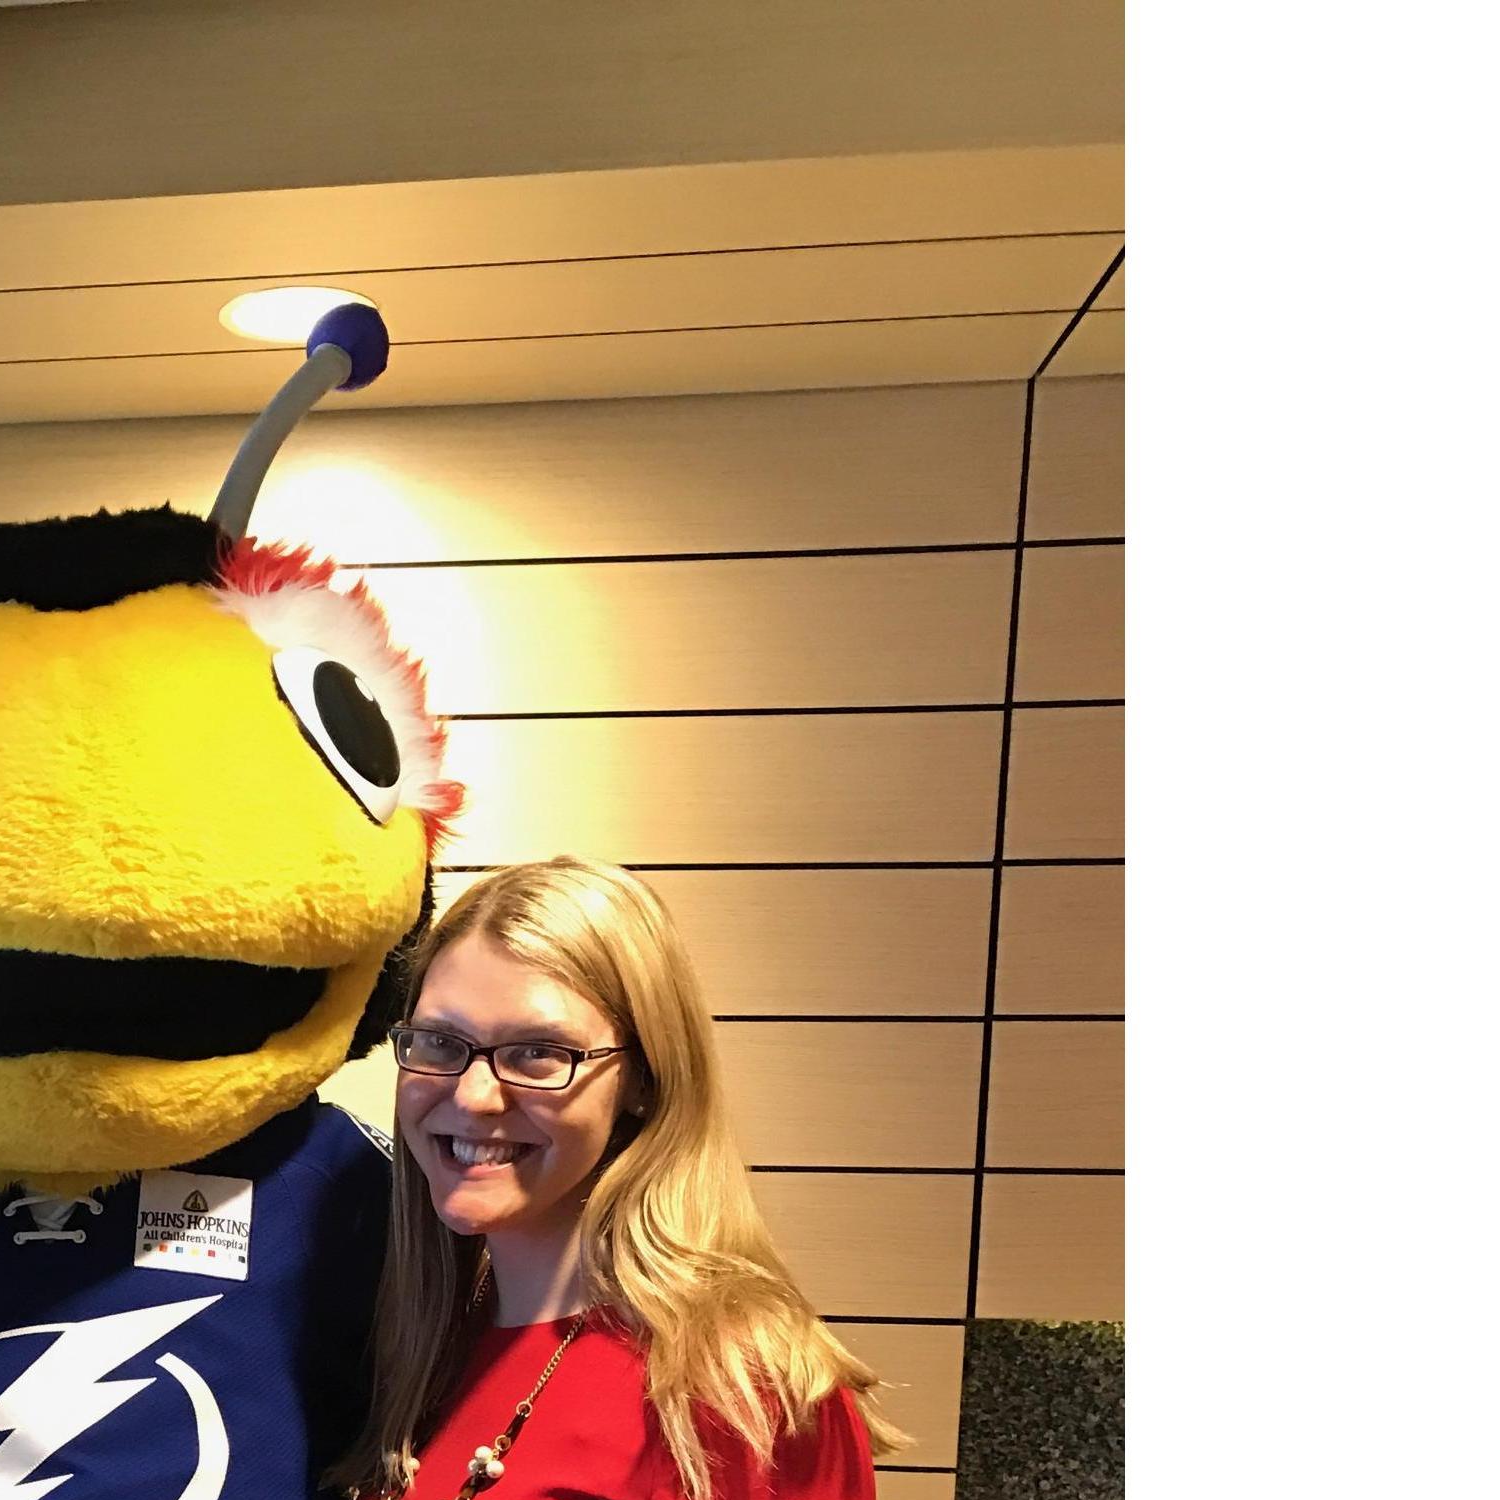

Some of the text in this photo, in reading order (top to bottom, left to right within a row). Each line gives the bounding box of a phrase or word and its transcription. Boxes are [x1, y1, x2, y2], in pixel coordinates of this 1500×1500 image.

[138, 1211, 249, 1238] JOHNS HOPKINS
[144, 1230, 247, 1252] All Children's Hospital
